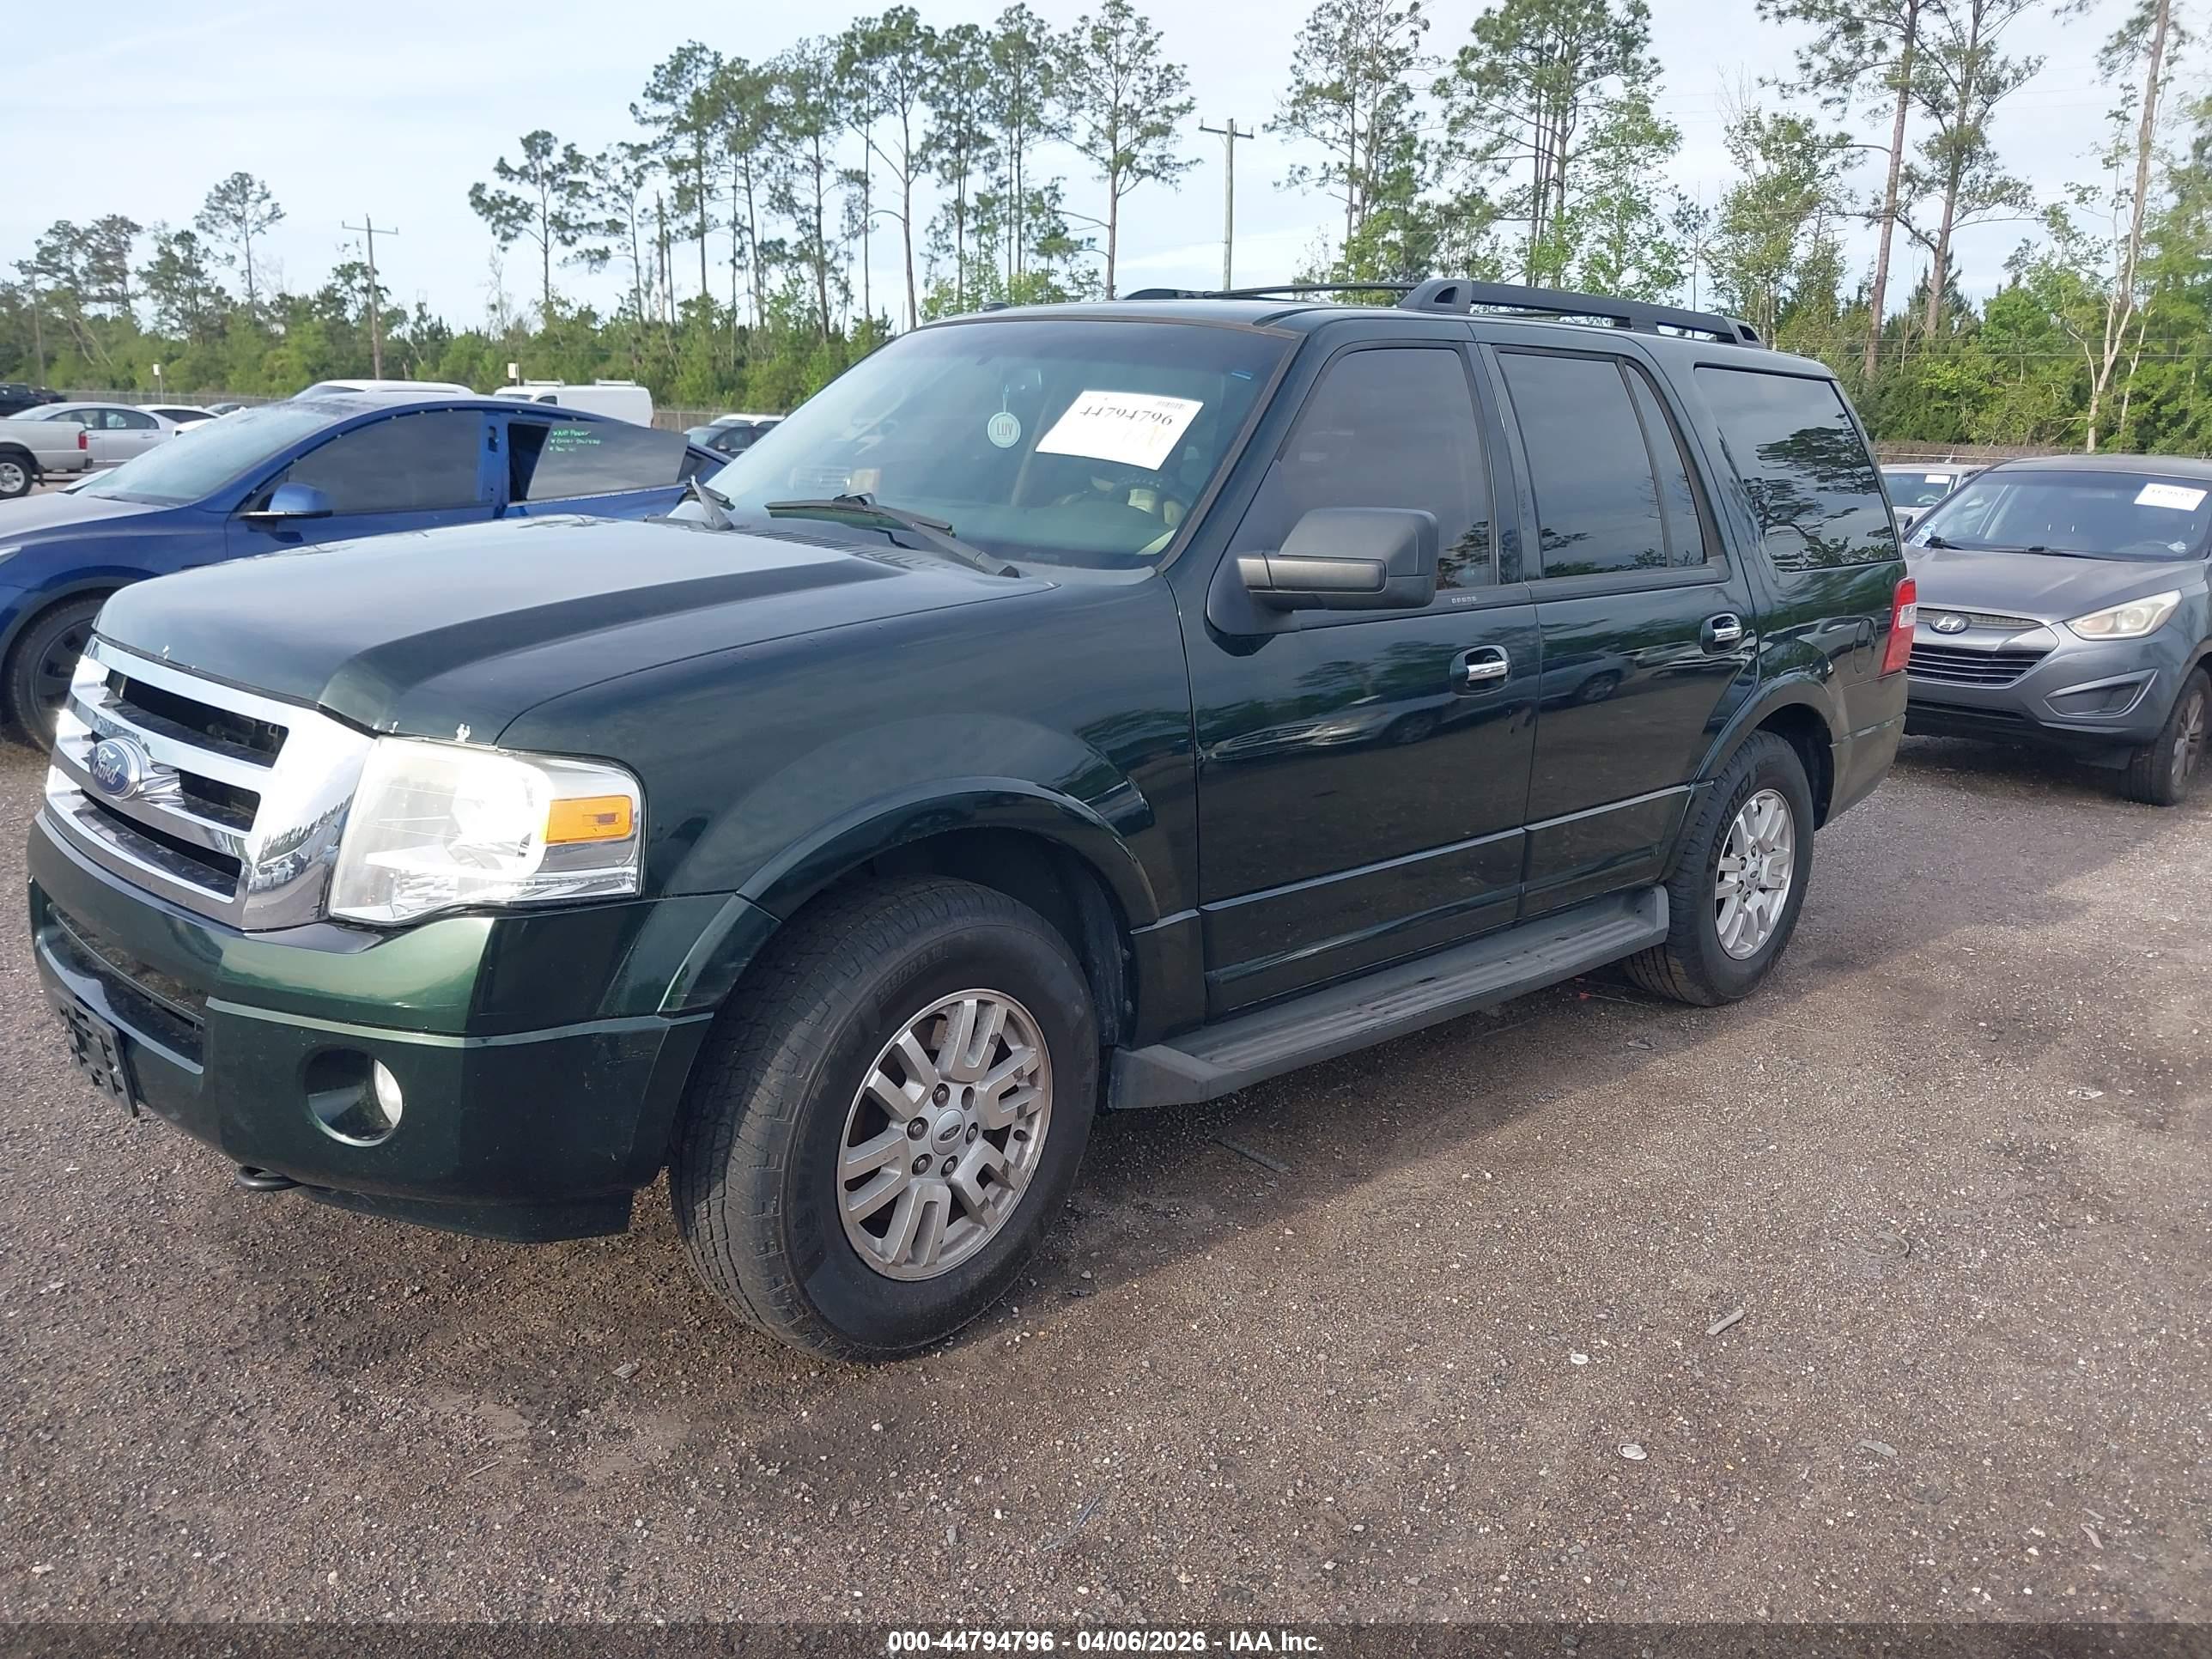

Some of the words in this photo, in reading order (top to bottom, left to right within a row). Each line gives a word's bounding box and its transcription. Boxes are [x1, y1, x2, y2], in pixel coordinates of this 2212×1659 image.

[1079, 404, 1173, 426] 44794796
[996, 422, 1014, 435] LUV
[92, 747, 122, 786] Ford
